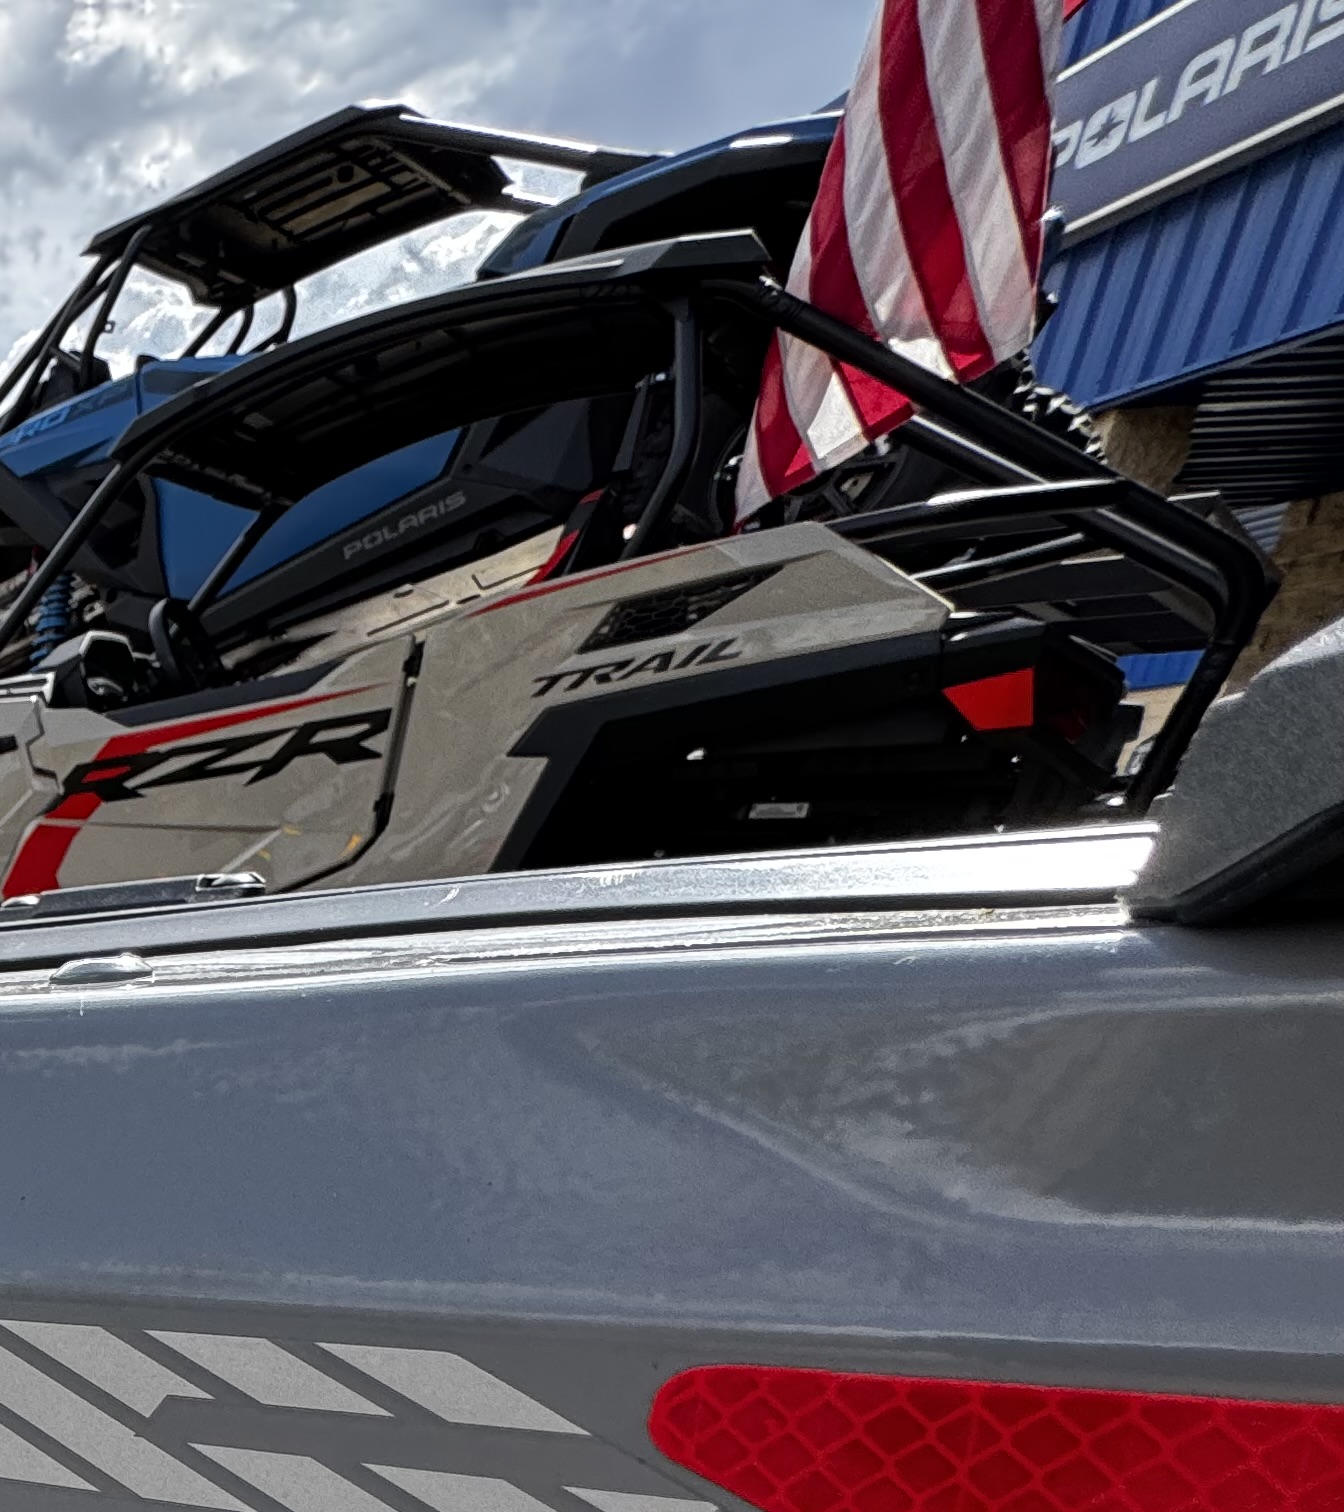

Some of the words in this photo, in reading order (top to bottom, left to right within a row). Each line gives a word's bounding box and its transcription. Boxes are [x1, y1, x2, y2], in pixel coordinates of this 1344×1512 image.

[343, 491, 467, 560] POLARIS
[531, 636, 743, 698] TRAIL
[38, 707, 393, 816] RZR
